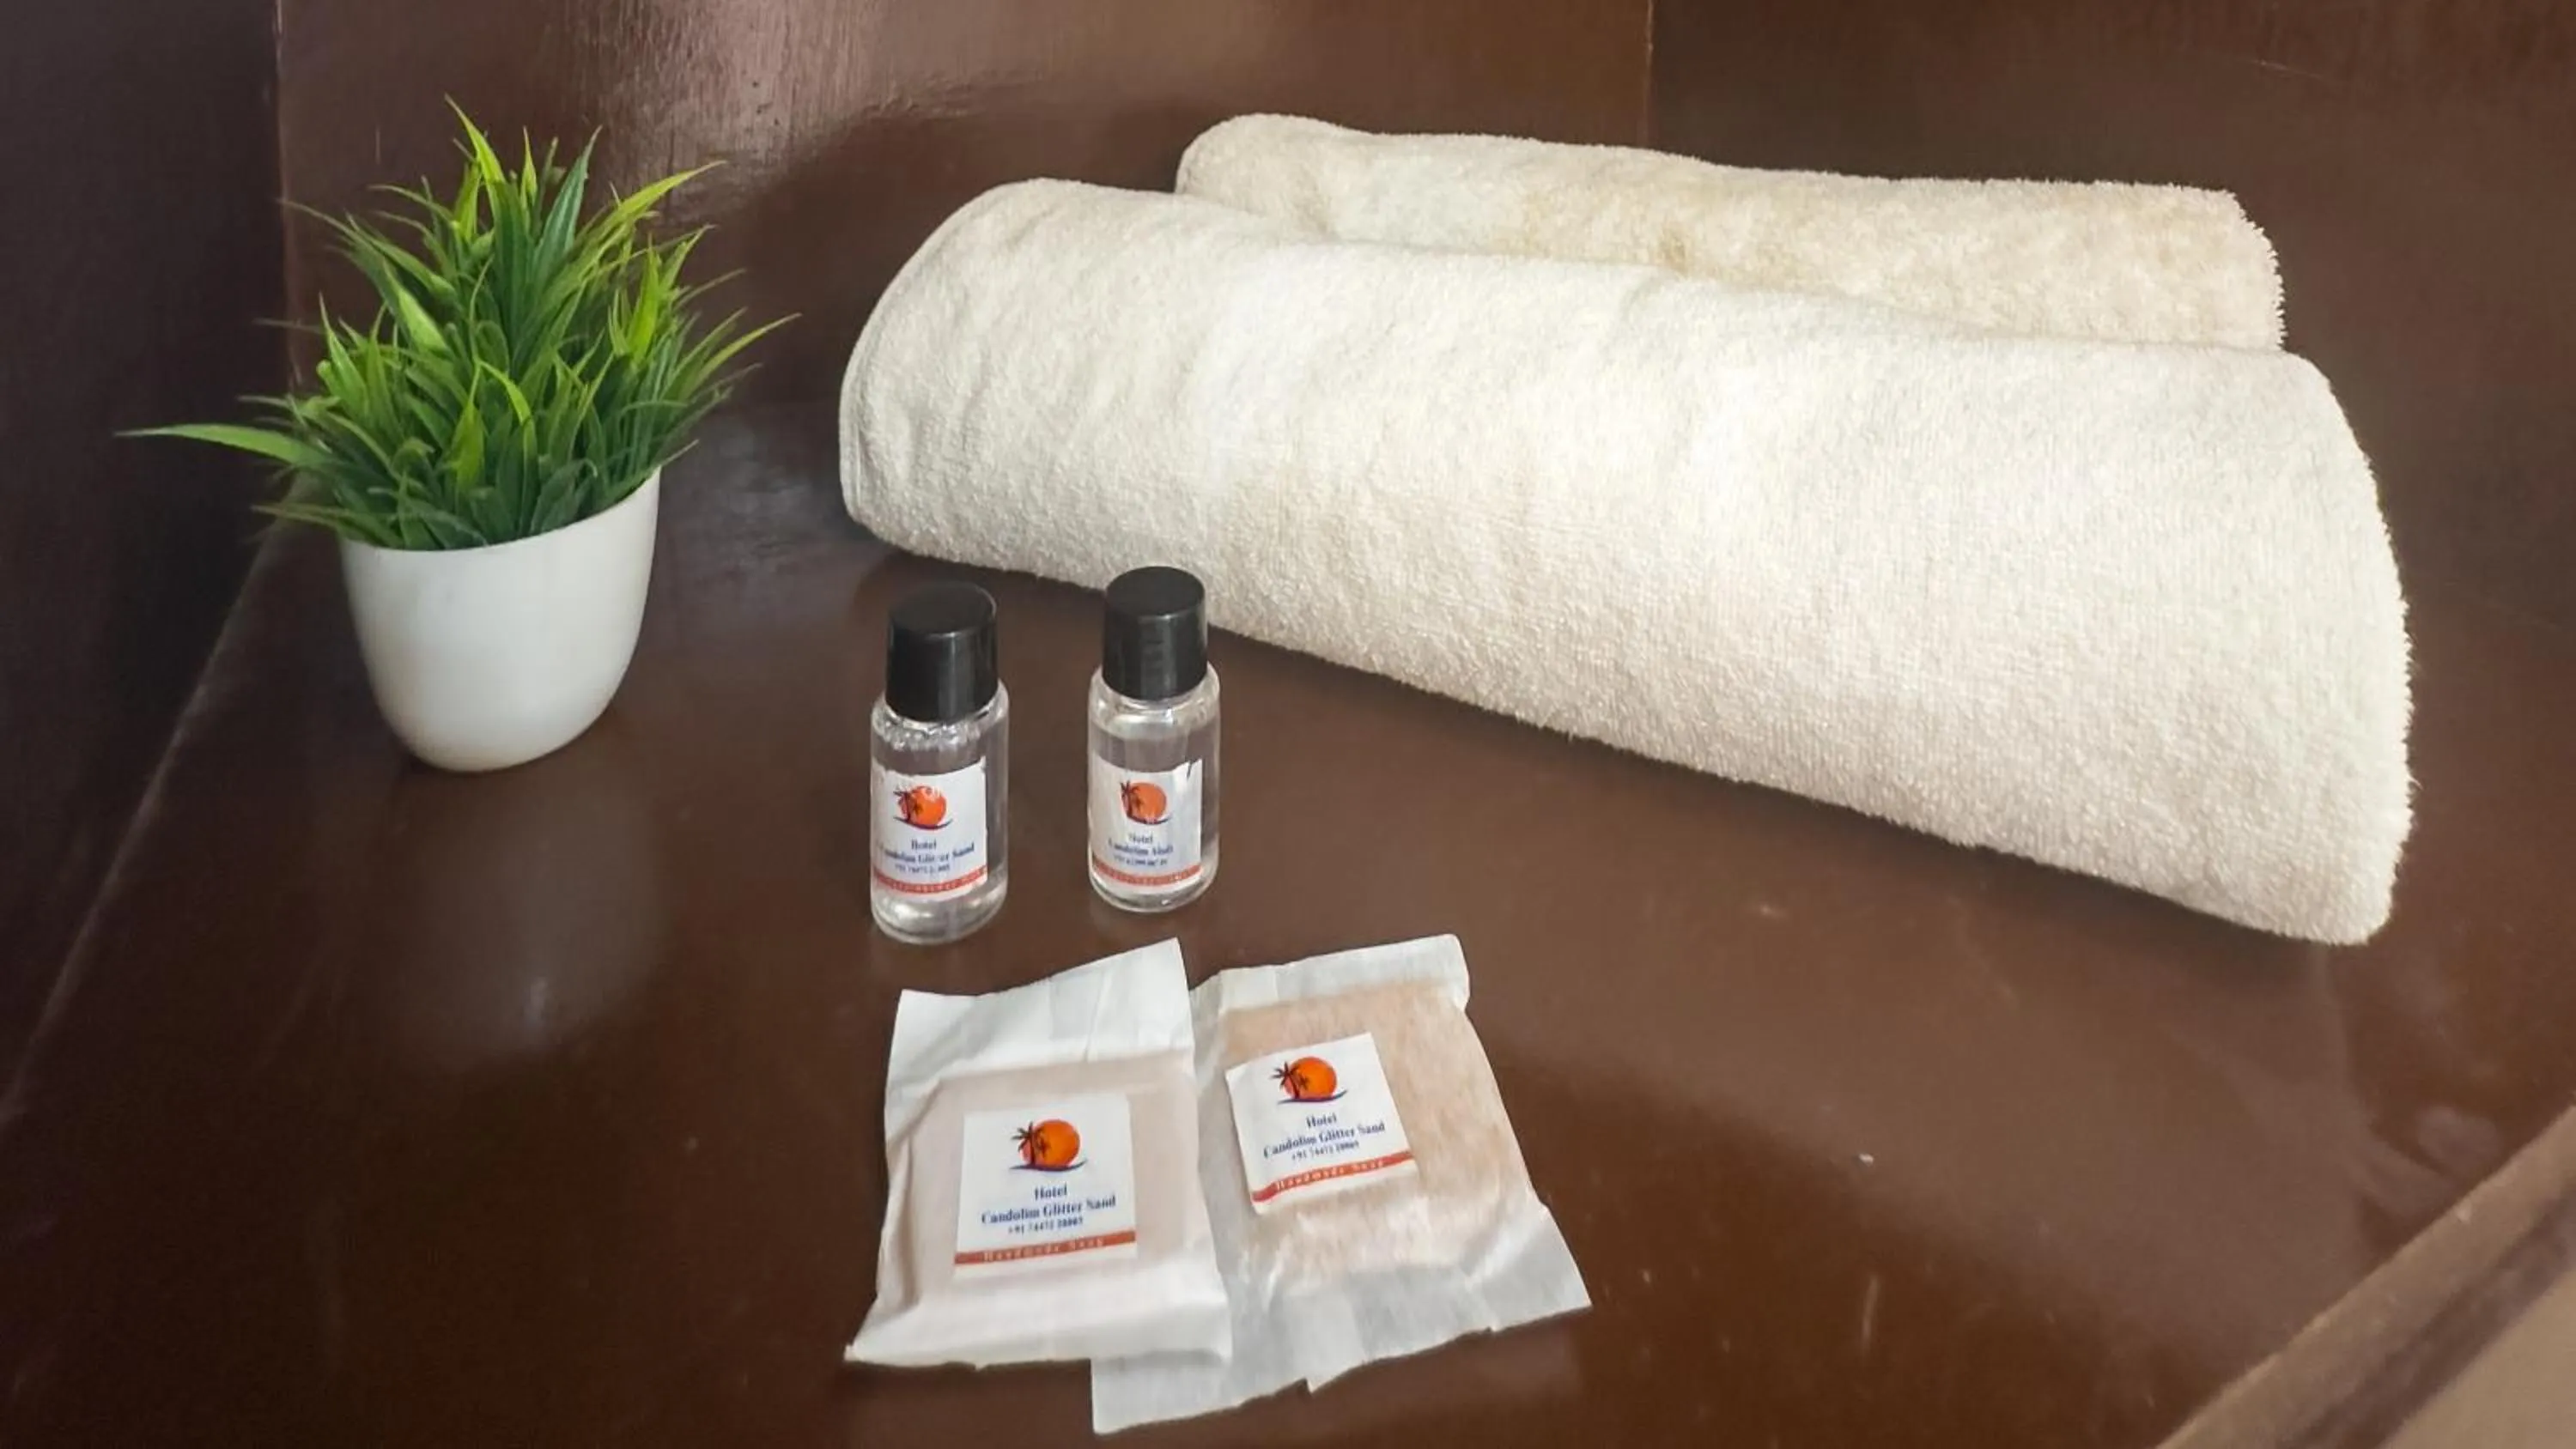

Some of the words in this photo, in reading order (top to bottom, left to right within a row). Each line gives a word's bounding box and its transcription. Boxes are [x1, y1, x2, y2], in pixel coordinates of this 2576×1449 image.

[1306, 1113, 1337, 1129] Hotel
[1263, 1135, 1317, 1159] Candolim
[1319, 1127, 1354, 1143] Glitter
[1358, 1121, 1385, 1135] Sand
[1035, 1182, 1067, 1201] Hotel
[981, 1206, 1040, 1224] Candolim
[1042, 1200, 1082, 1216] Glitter
[1086, 1193, 1116, 1210] Sand
